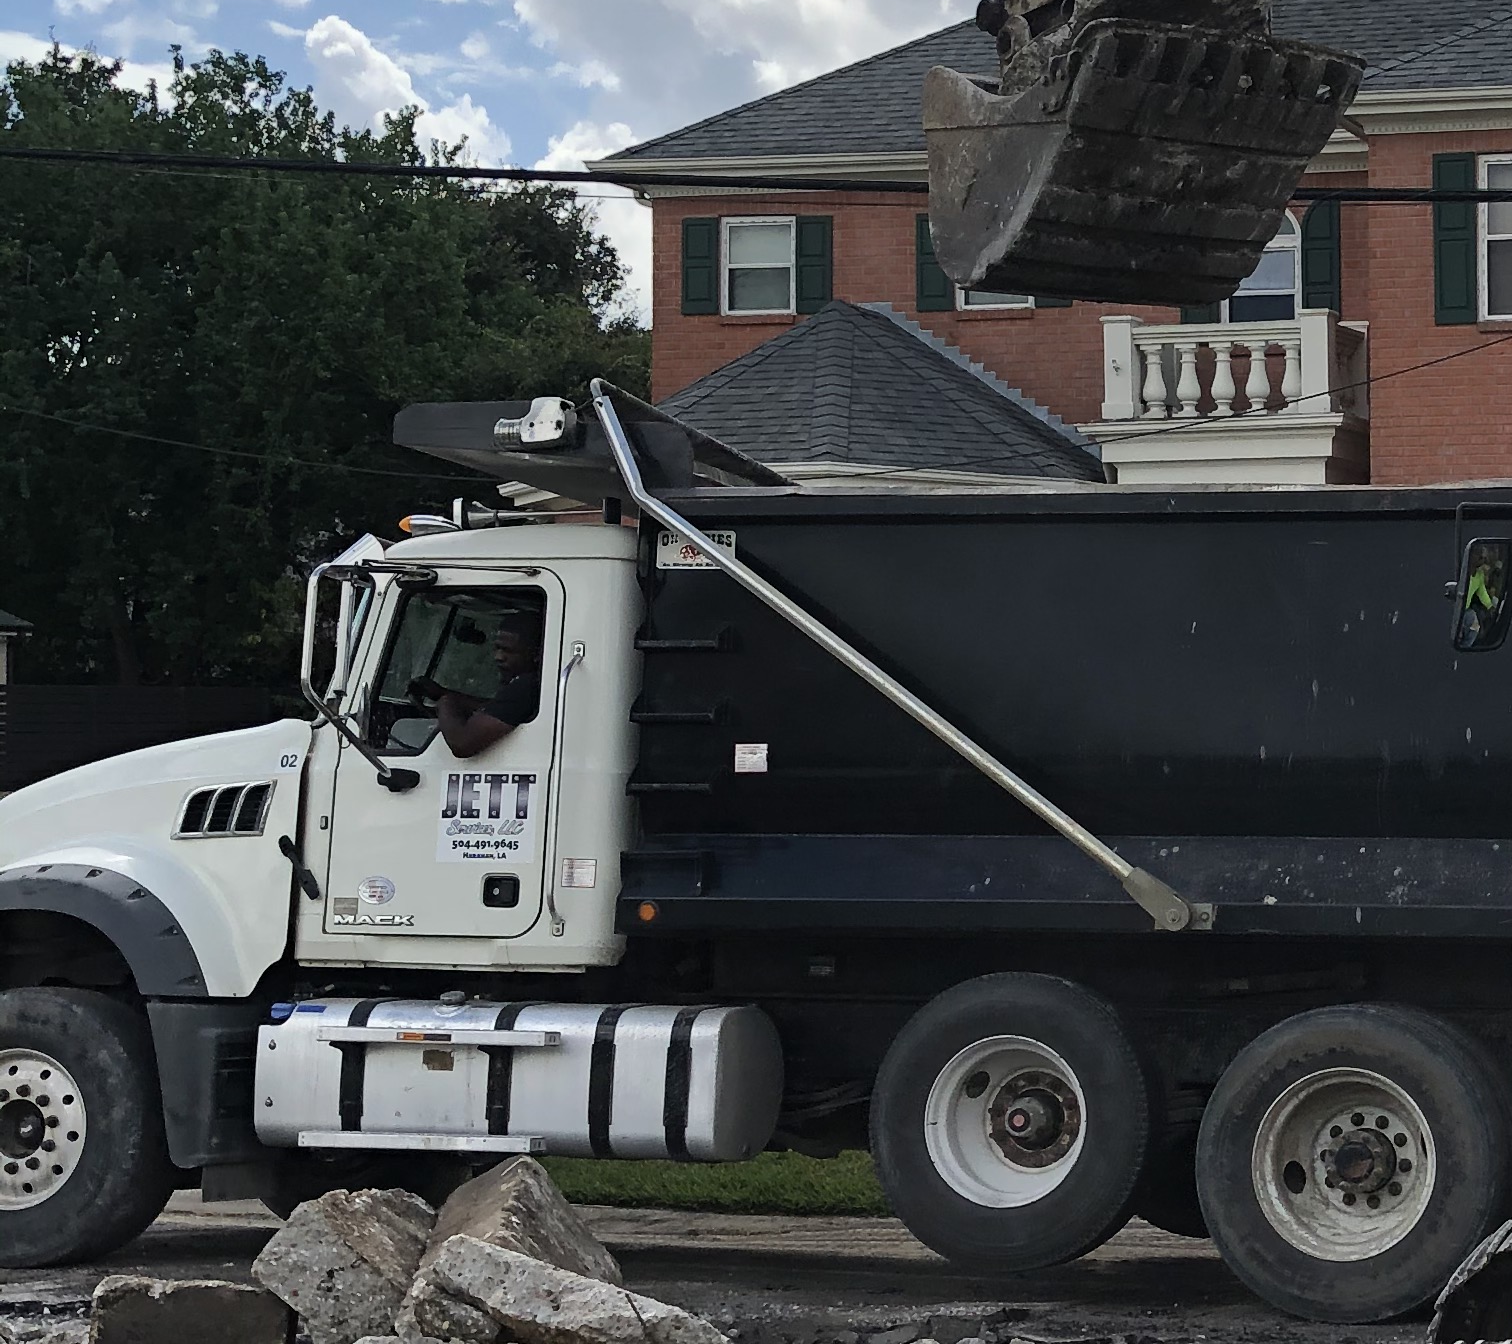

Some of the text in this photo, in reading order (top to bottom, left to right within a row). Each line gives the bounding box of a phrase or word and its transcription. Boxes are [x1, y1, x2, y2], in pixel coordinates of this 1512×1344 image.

[280, 753, 298, 768] 02
[441, 773, 537, 820] JETT
[333, 914, 415, 927] MACK
